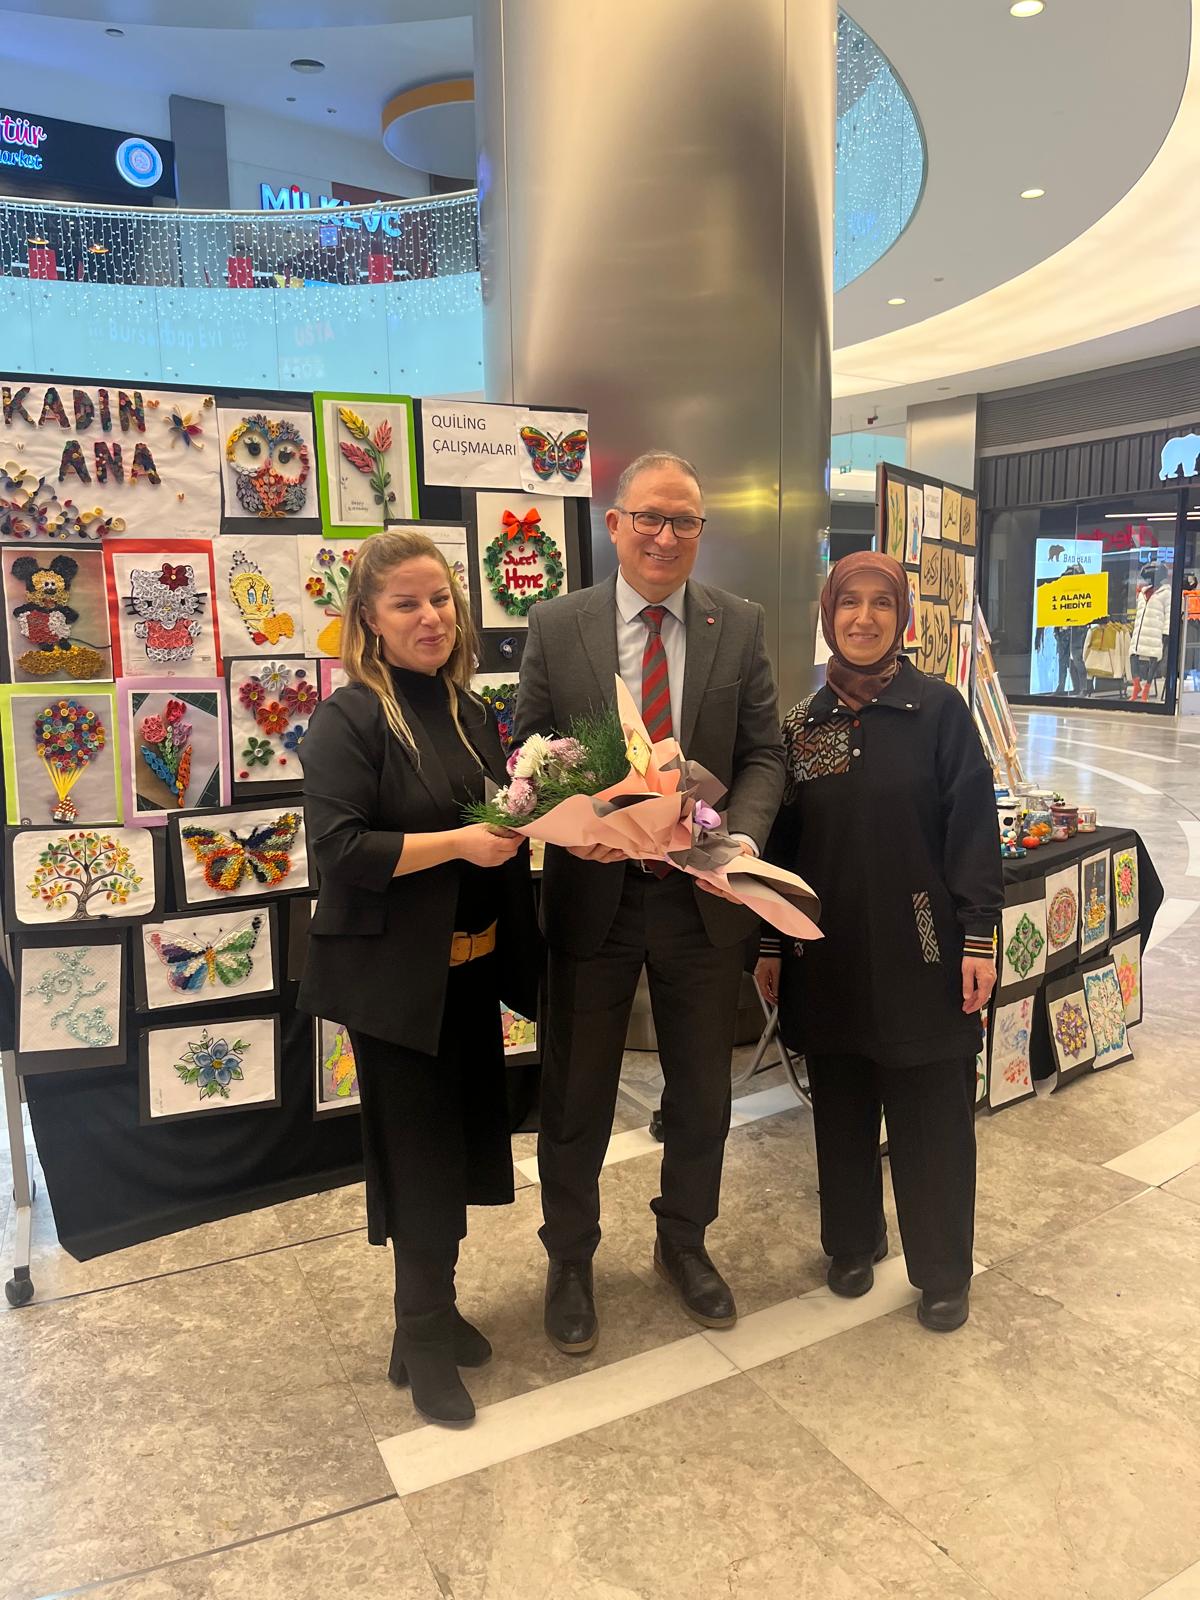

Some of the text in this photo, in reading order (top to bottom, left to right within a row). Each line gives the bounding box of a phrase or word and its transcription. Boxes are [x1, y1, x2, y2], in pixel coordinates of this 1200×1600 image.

[0, 114, 47, 148] tür
[0, 149, 43, 170] arket
[2, 386, 146, 433] KADIN
[431, 413, 486, 431] QUİLİNG
[432, 439, 517, 456] ÇALIŞMALARI
[58, 440, 161, 485] ANA
[503, 550, 538, 566] Sweet
[1060, 593, 1091, 601] ALANA
[1060, 601, 1092, 609] HEDİYE
